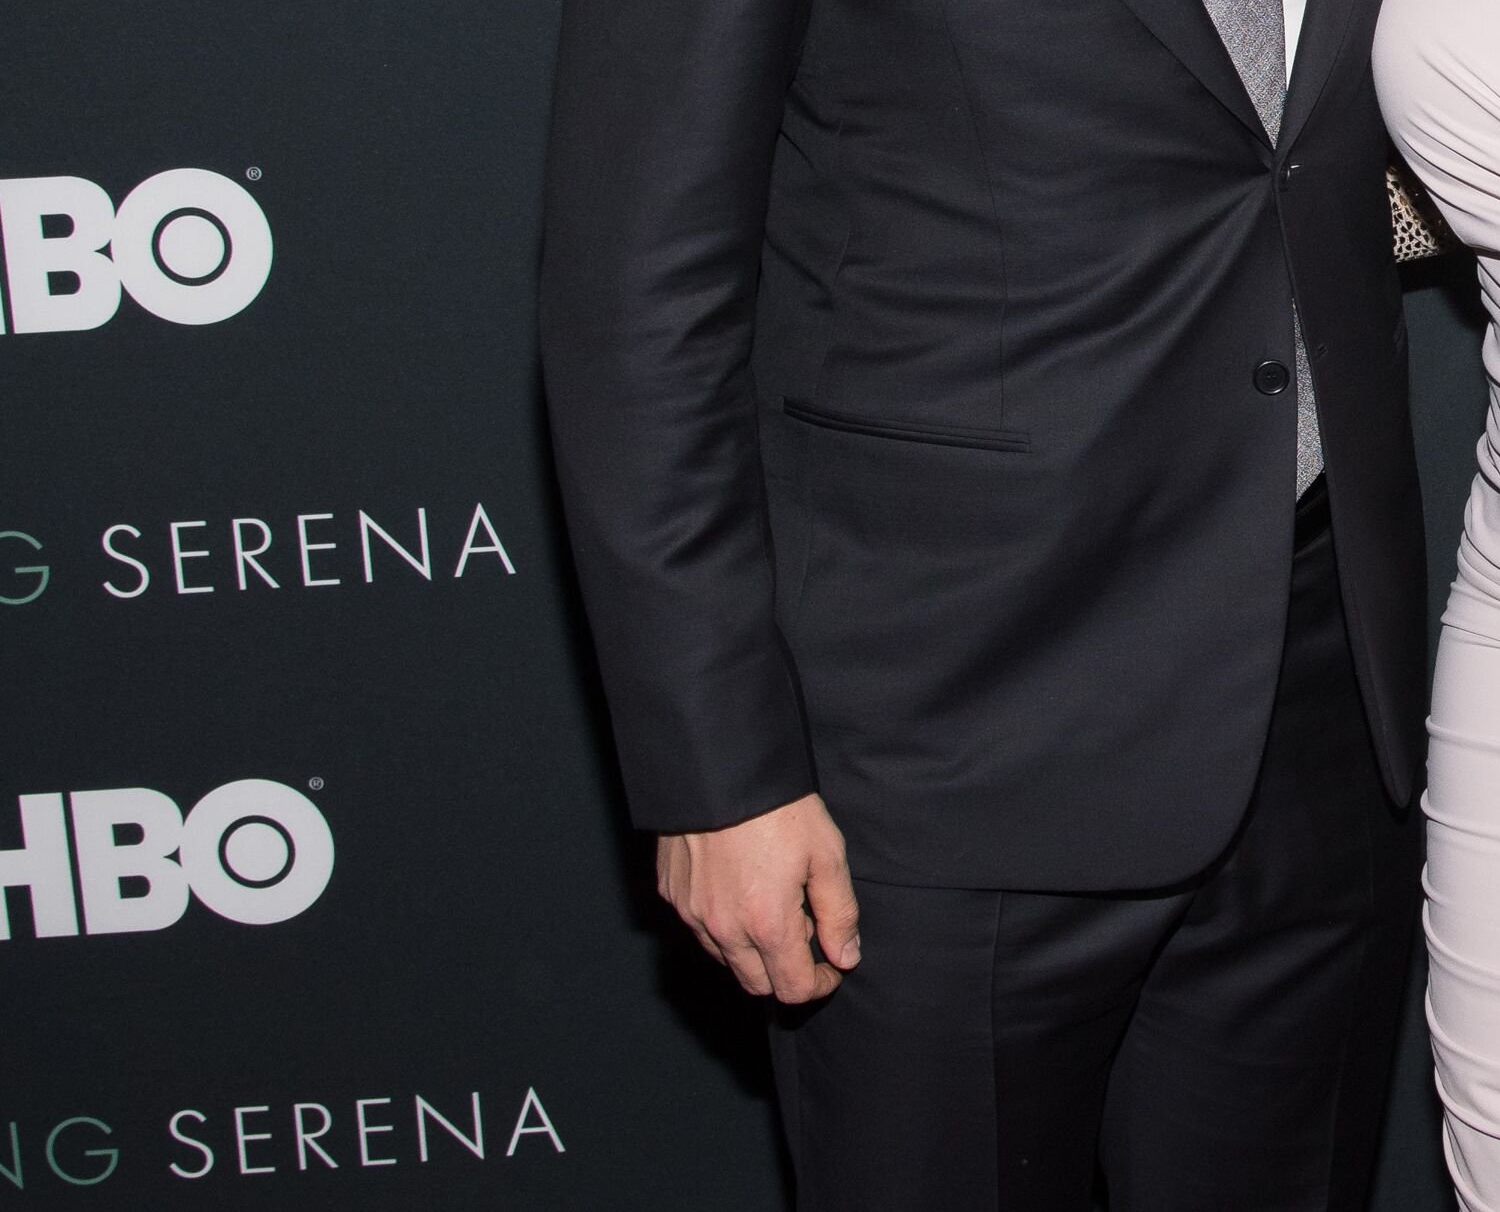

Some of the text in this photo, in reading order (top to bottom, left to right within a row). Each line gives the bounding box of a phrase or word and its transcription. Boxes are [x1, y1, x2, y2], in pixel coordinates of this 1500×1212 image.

[0, 167, 273, 334] BO
[101, 502, 517, 599] SERENA
[168, 1086, 566, 1181] SERENA
